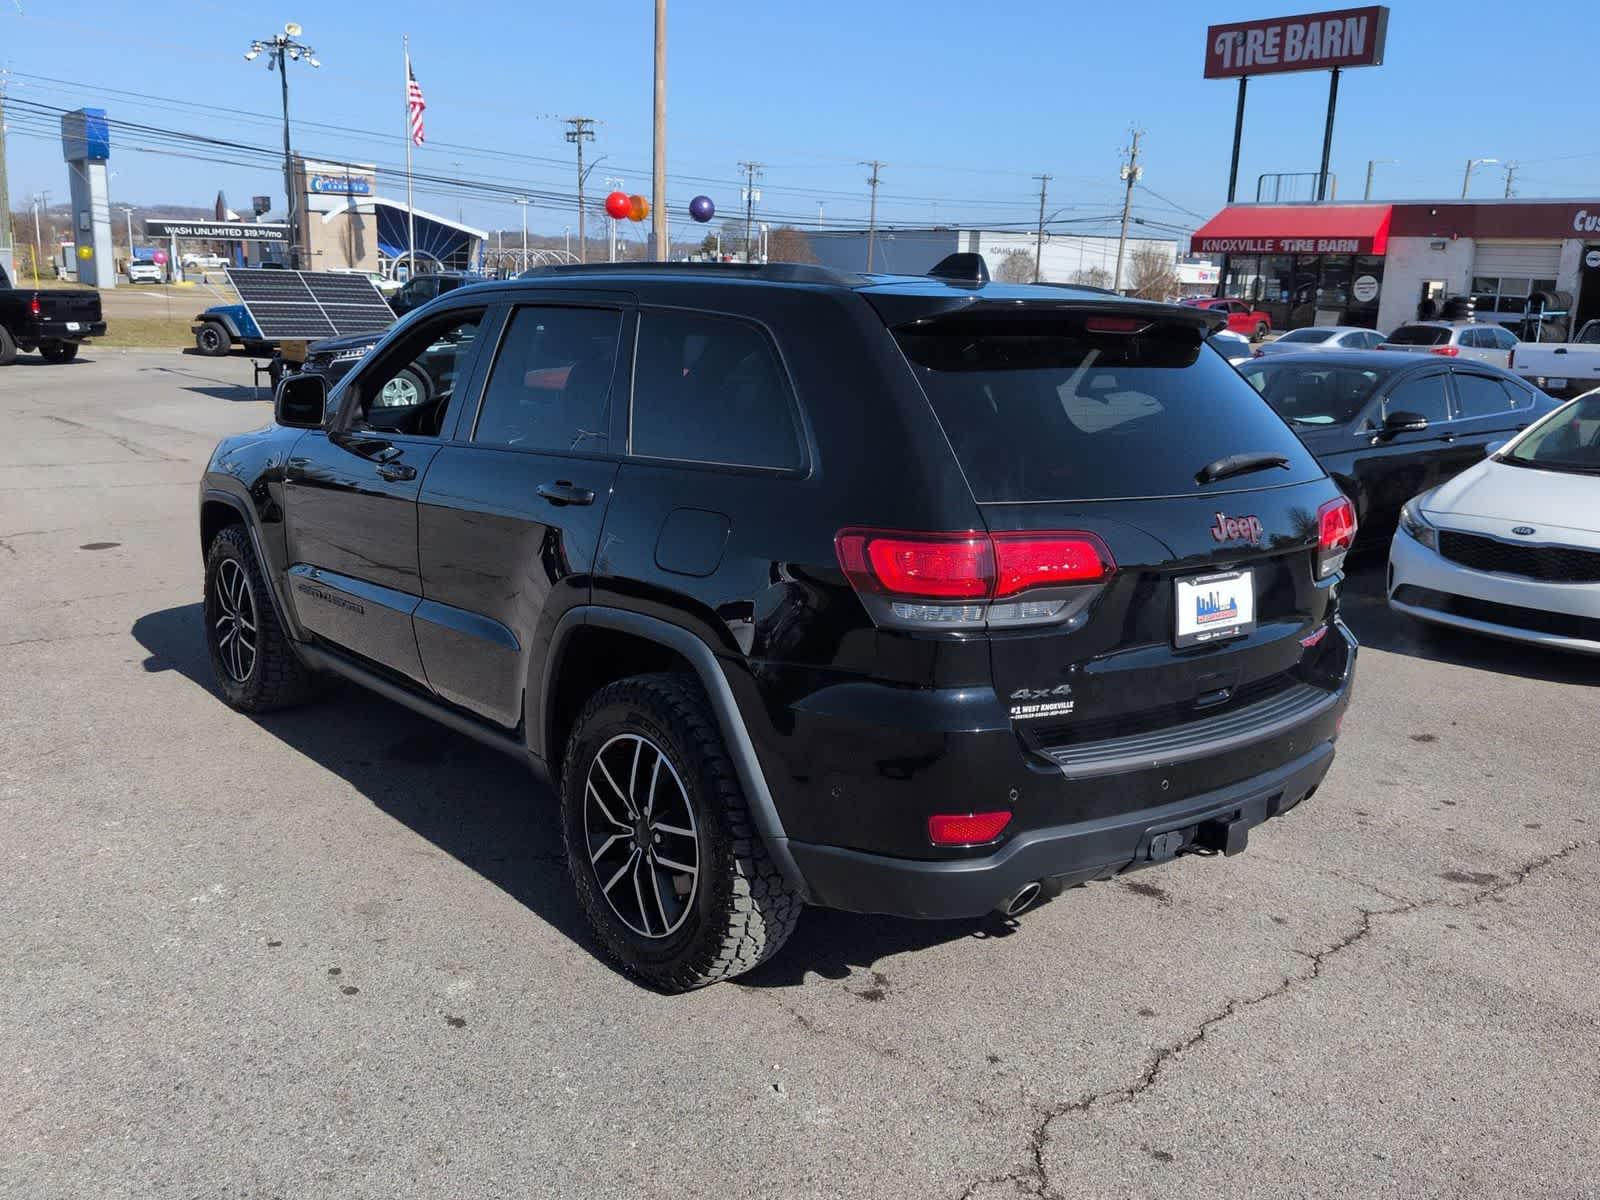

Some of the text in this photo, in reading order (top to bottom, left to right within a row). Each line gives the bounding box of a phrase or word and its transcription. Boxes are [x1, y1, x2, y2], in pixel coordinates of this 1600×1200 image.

[1283, 15, 1368, 62] BARN
[164, 226, 192, 235] WASH
[194, 227, 241, 237] UNLIMITED
[1202, 239, 1274, 251] KNOXVILLE
[1318, 239, 1359, 252] BARN
[1210, 512, 1263, 545] Jeep
[1010, 684, 1072, 699] 4x4
[1010, 705, 1021, 715] #1
[1022, 704, 1040, 713] WEST
[1041, 700, 1074, 711] KNOXVILLE
